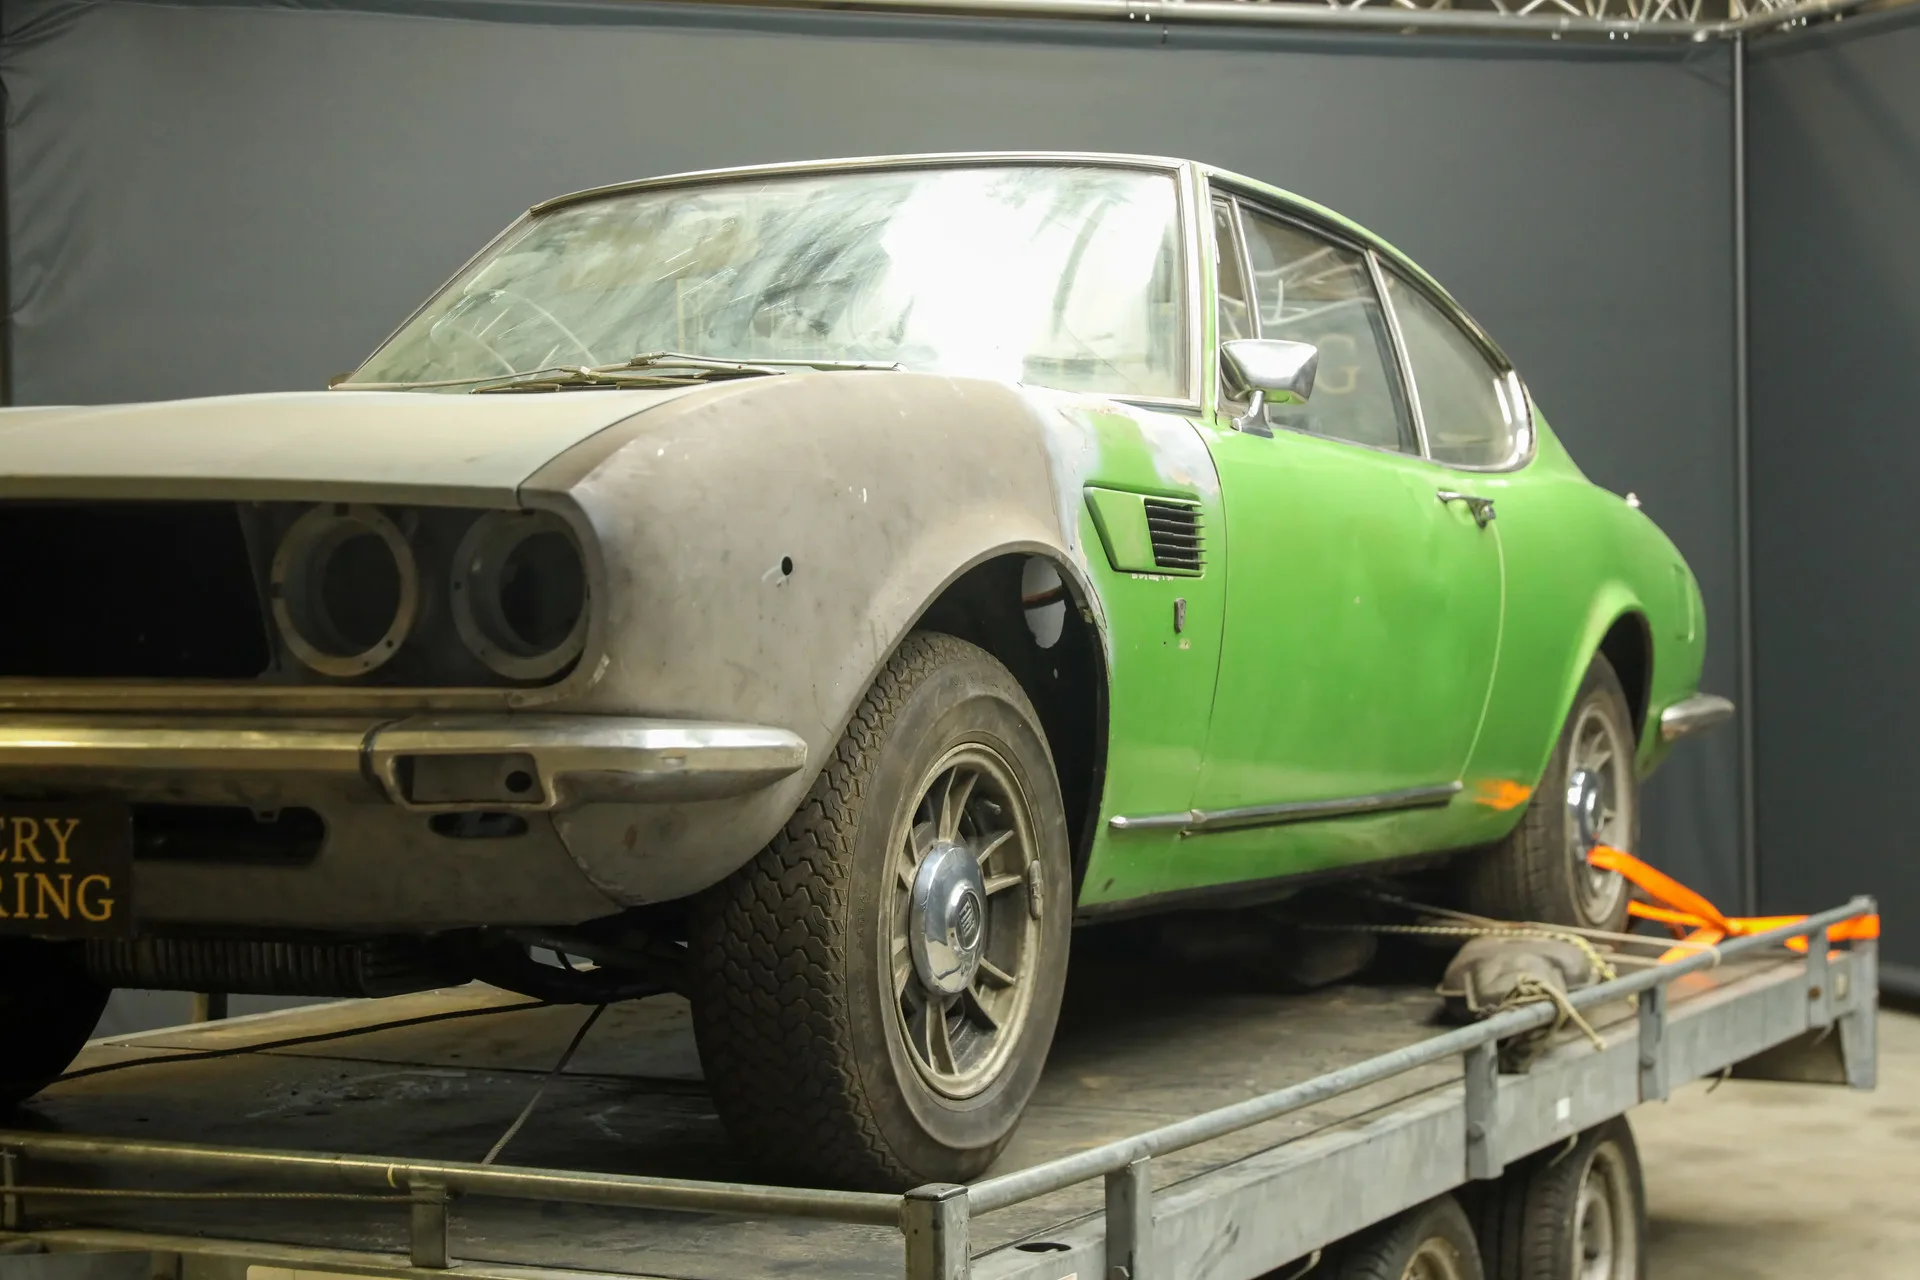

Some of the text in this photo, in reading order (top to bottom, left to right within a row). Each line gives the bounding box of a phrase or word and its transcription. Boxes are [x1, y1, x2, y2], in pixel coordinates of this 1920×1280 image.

[0, 817, 80, 864] RY
[0, 872, 115, 921] ING
[958, 901, 976, 938] FIAT
